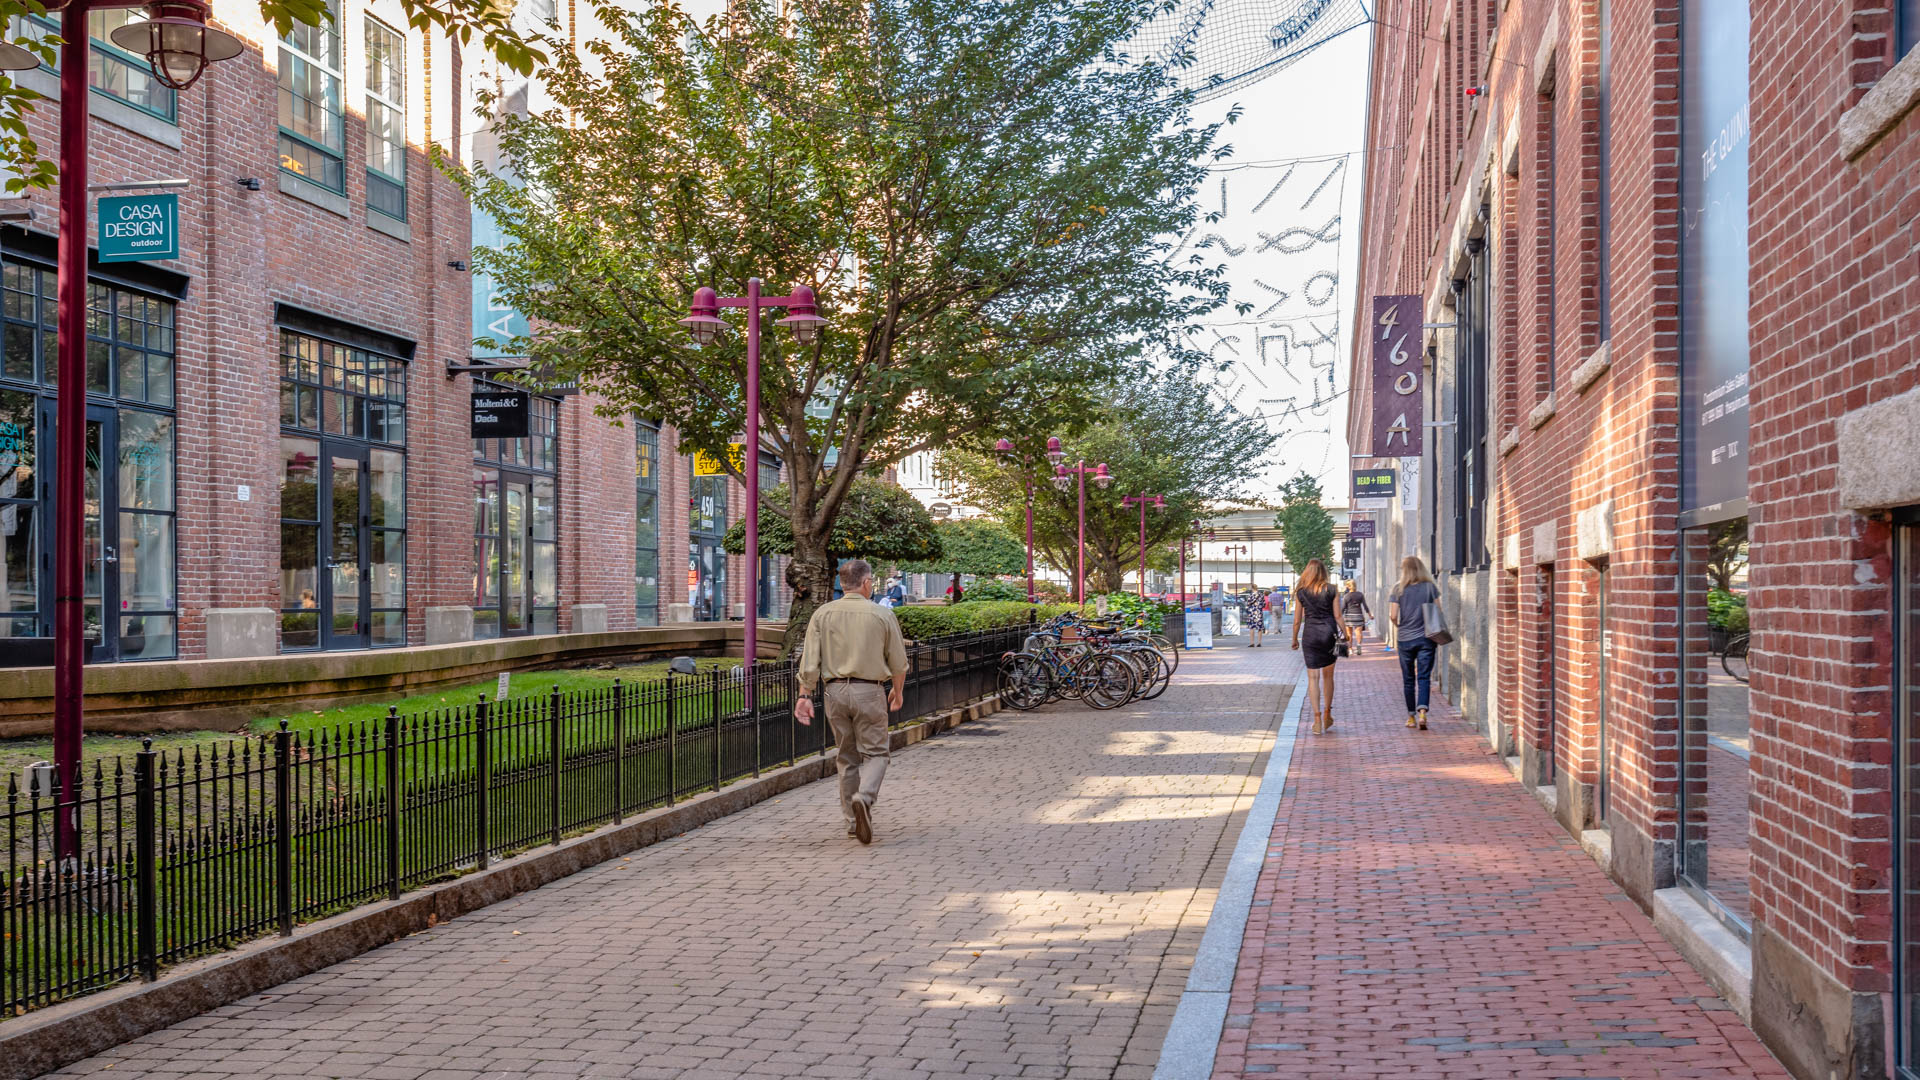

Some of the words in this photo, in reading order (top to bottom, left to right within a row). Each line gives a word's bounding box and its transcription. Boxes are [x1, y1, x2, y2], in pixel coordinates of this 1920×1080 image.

[1702, 137, 1718, 181] THE
[120, 204, 162, 220] CASA
[105, 221, 163, 238] DESIGN
[475, 398, 518, 408] Molteni&C
[474, 414, 499, 423] Dada
[0, 422, 20, 436] ASA
[701, 495, 714, 517] 450
